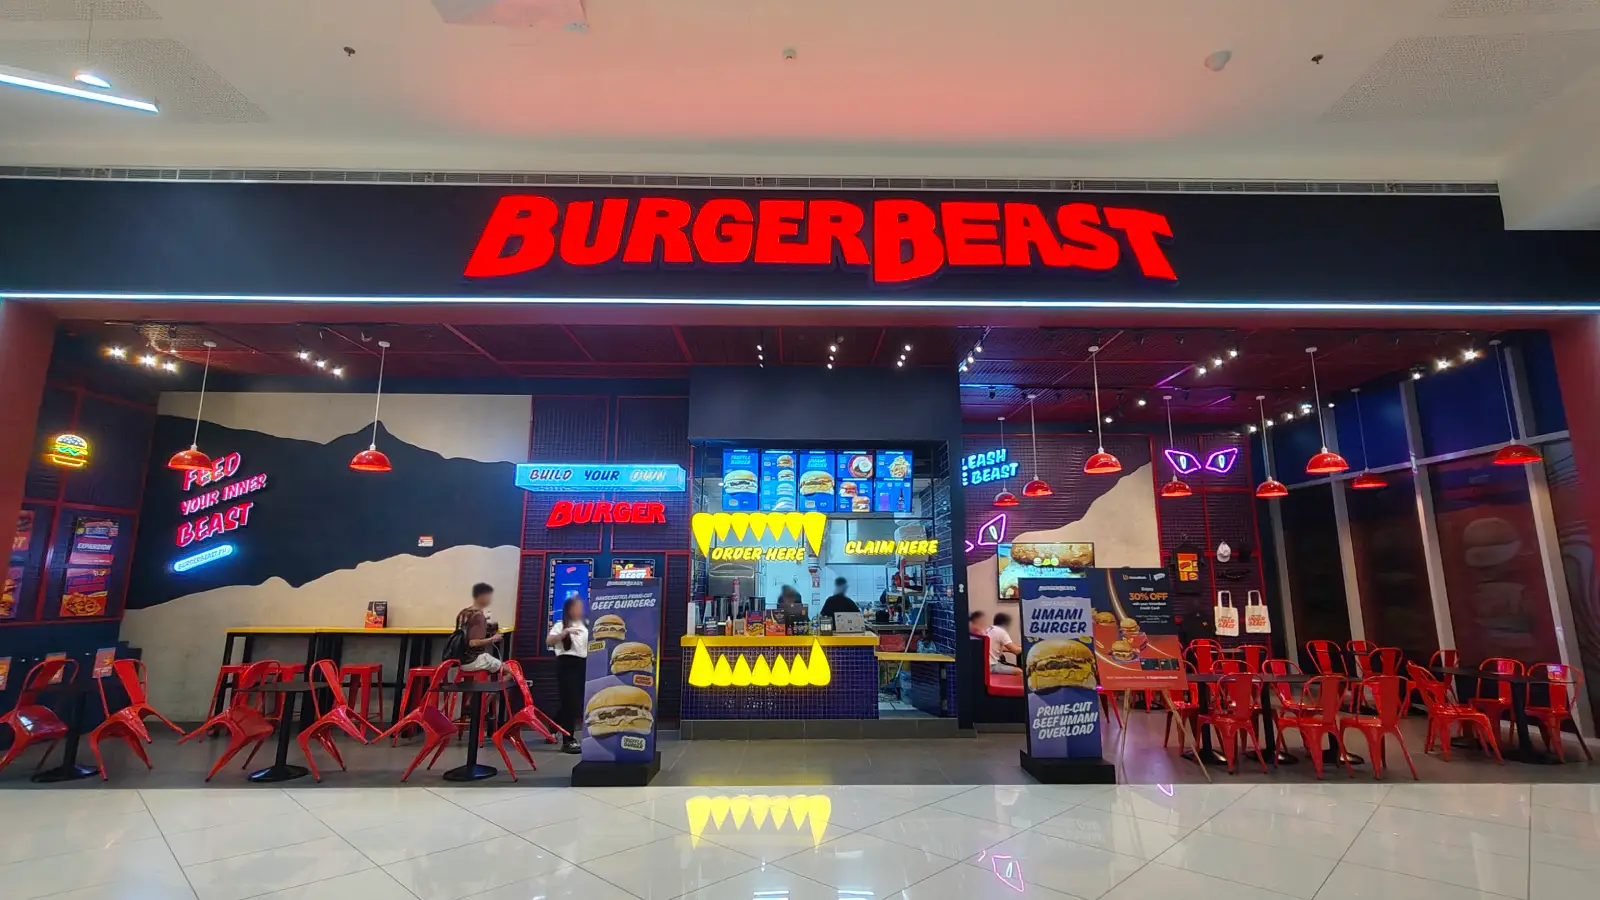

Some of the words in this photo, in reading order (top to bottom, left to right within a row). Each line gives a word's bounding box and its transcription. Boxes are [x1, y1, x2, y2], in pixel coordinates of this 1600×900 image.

[463, 195, 1177, 282] BURGERBEAST
[182, 452, 241, 491] FEED
[529, 469, 572, 480] BUILD
[584, 470, 620, 481] YOUR
[630, 470, 666, 481] OWN
[971, 463, 1019, 485] BEAST
[180, 490, 219, 515] YOUR
[222, 473, 267, 501] INNER
[546, 501, 666, 528] BURGER
[176, 502, 253, 547] BEAST
[712, 547, 762, 561] ORDER
[765, 547, 805, 561] HERE
[845, 540, 894, 555] CLAIM
[896, 539, 938, 555] HERE
[1129, 592, 1149, 600] 30%
[1150, 592, 1168, 600] OFF
[591, 601, 614, 610] BEEF
[614, 599, 656, 609] BURGERS
[1031, 608, 1083, 620] UMAMI
[1029, 621, 1087, 633] BURGER
[1036, 701, 1093, 717] PRIME-CUT
[1032, 716, 1059, 729] BEEF
[1060, 712, 1099, 725] UMAMI
[1038, 723, 1095, 740] OVERLOAD
